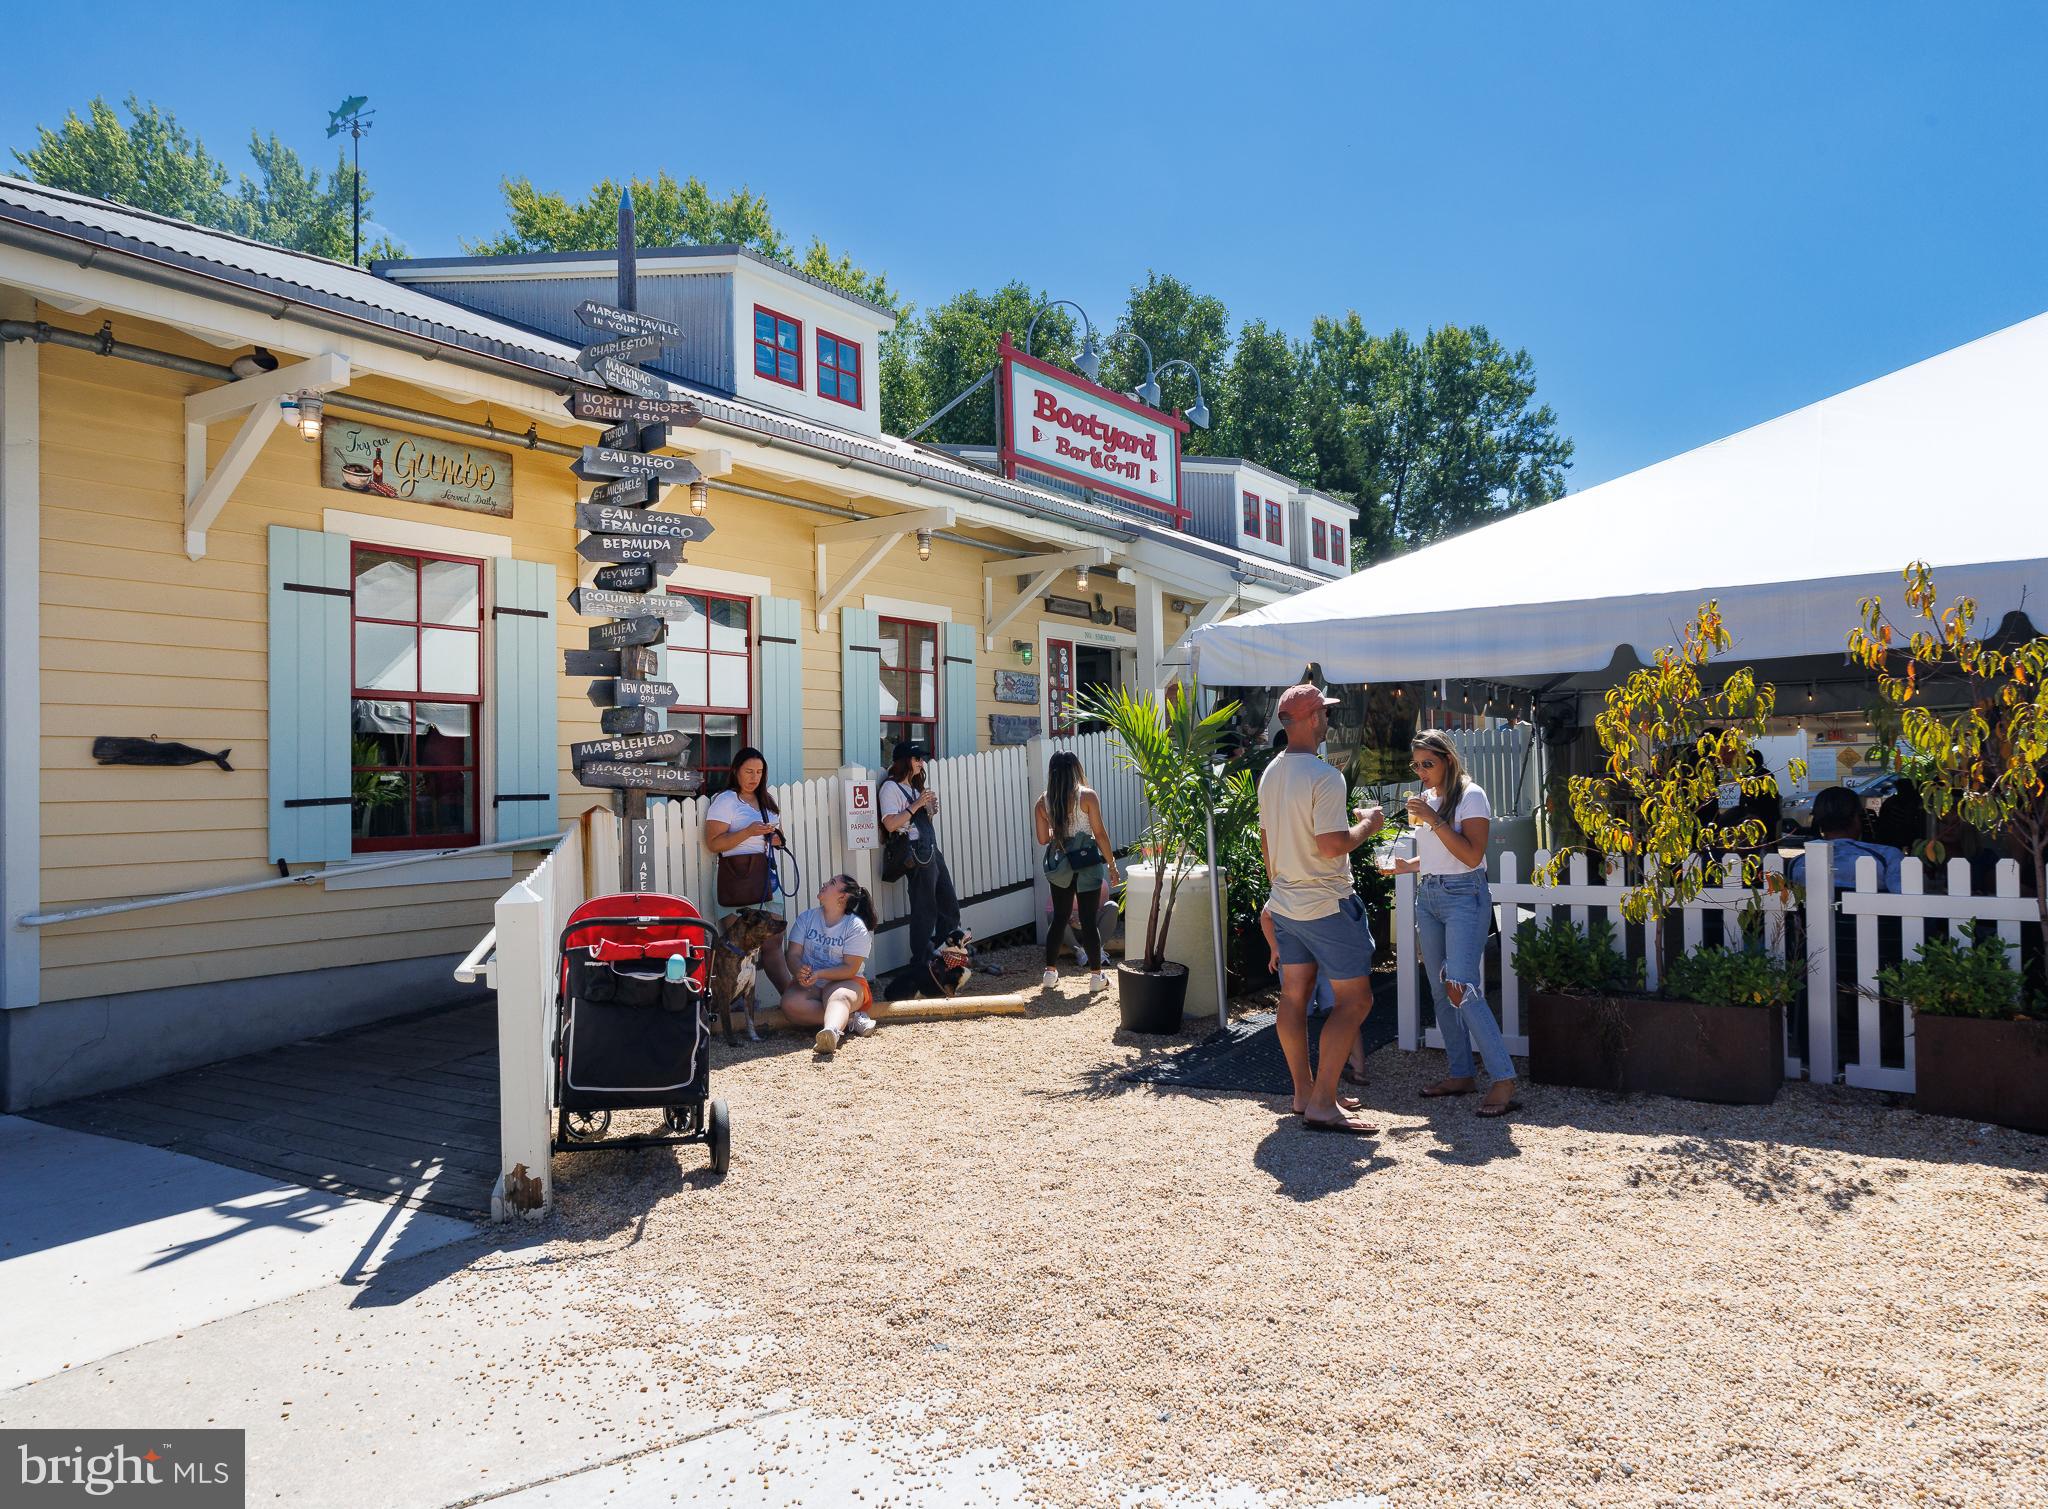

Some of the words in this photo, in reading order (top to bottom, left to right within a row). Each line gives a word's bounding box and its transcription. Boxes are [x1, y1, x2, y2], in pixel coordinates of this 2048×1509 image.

[585, 303, 680, 336] MARGARITAVILLE
[593, 317, 604, 325] IN
[607, 320, 638, 334] YOUR
[590, 335, 655, 358] CHARLESTON
[605, 359, 651, 385] MACKINAC
[606, 370, 639, 392] ISLAND
[582, 393, 633, 409] NORTH
[638, 400, 692, 414] SHORE
[582, 405, 622, 418] OAHU
[604, 423, 629, 441] TORTOLA
[1033, 389, 1158, 461] Boatyard
[346, 428, 372, 456] Try
[372, 437, 391, 448] our
[393, 436, 496, 498] Gumbo
[600, 451, 627, 463] SAN
[632, 454, 675, 470] DIEGO
[1056, 435, 1089, 461] Bar
[1103, 454, 1141, 481] Grill
[607, 477, 642, 496] MICHAELS
[441, 488, 471, 504] Served
[472, 493, 498, 511] Daily
[600, 508, 633, 520] SAN
[647, 515, 681, 525] 2465
[600, 519, 694, 539] FRANCISCO
[602, 538, 671, 550] BERMUDA
[600, 570, 619, 581] KEY
[620, 567, 647, 577] WEST
[585, 592, 646, 605] COLUMBIA
[650, 598, 683, 608] RIVER
[601, 619, 638, 638] HALIFAX
[621, 682, 637, 693] NEW
[640, 684, 672, 696] ORLEANS
[580, 734, 675, 756] MARBLEHEAD
[657, 770, 691, 781] HOLE
[850, 823, 875, 831] PARKING
[638, 825, 648, 854] YOU
[855, 836, 870, 844] ONLY
[639, 861, 648, 891] ARE
[806, 928, 845, 947] Oxford
